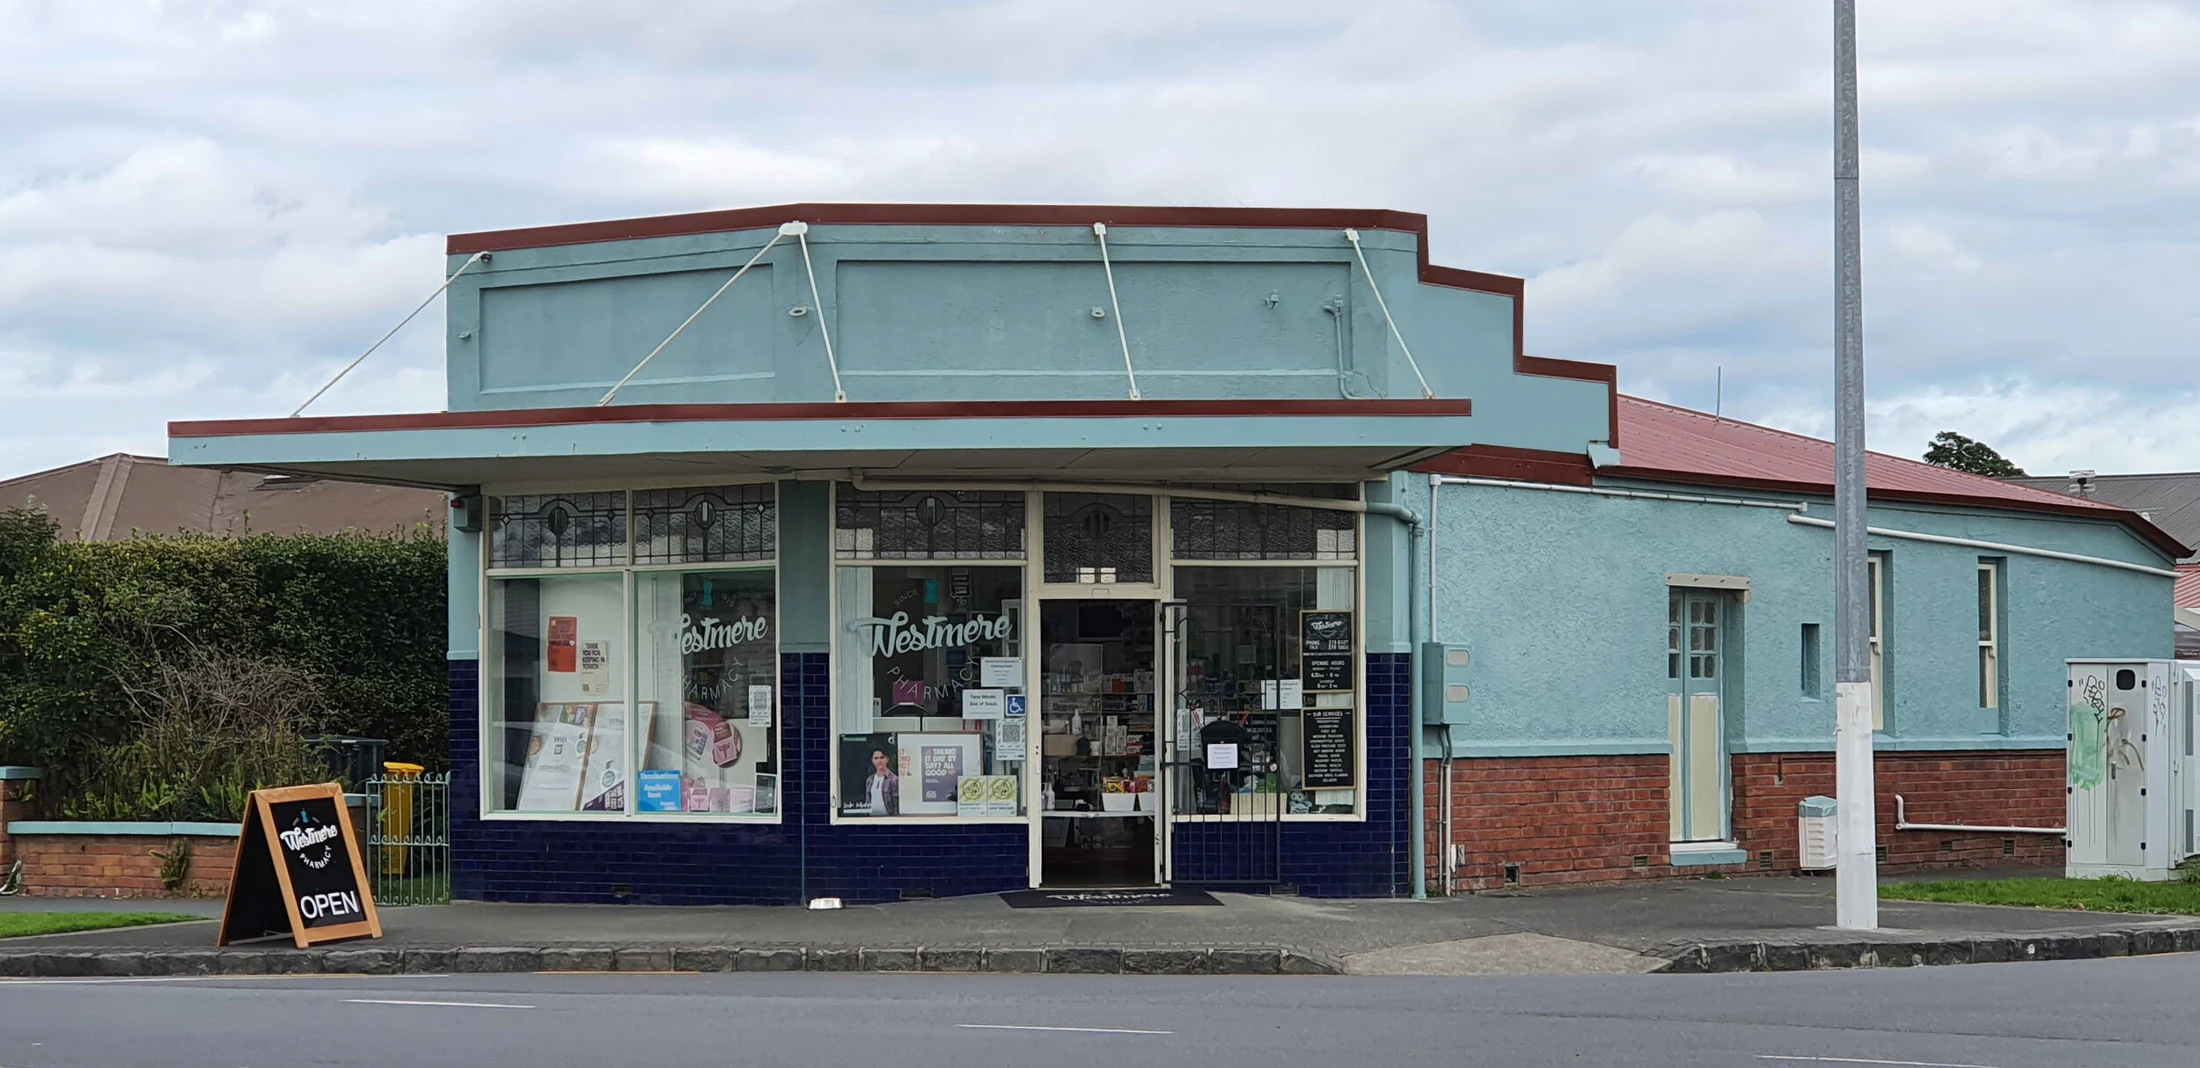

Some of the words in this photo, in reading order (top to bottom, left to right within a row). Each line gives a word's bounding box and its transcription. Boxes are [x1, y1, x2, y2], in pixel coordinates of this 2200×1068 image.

[847, 611, 1013, 658] Westmere
[680, 656, 744, 701] HARMACY
[886, 656, 980, 700] PHARMACY
[280, 824, 338, 851] Westmere
[299, 844, 332, 869] PHARMACY
[300, 890, 359, 919] OPEN
